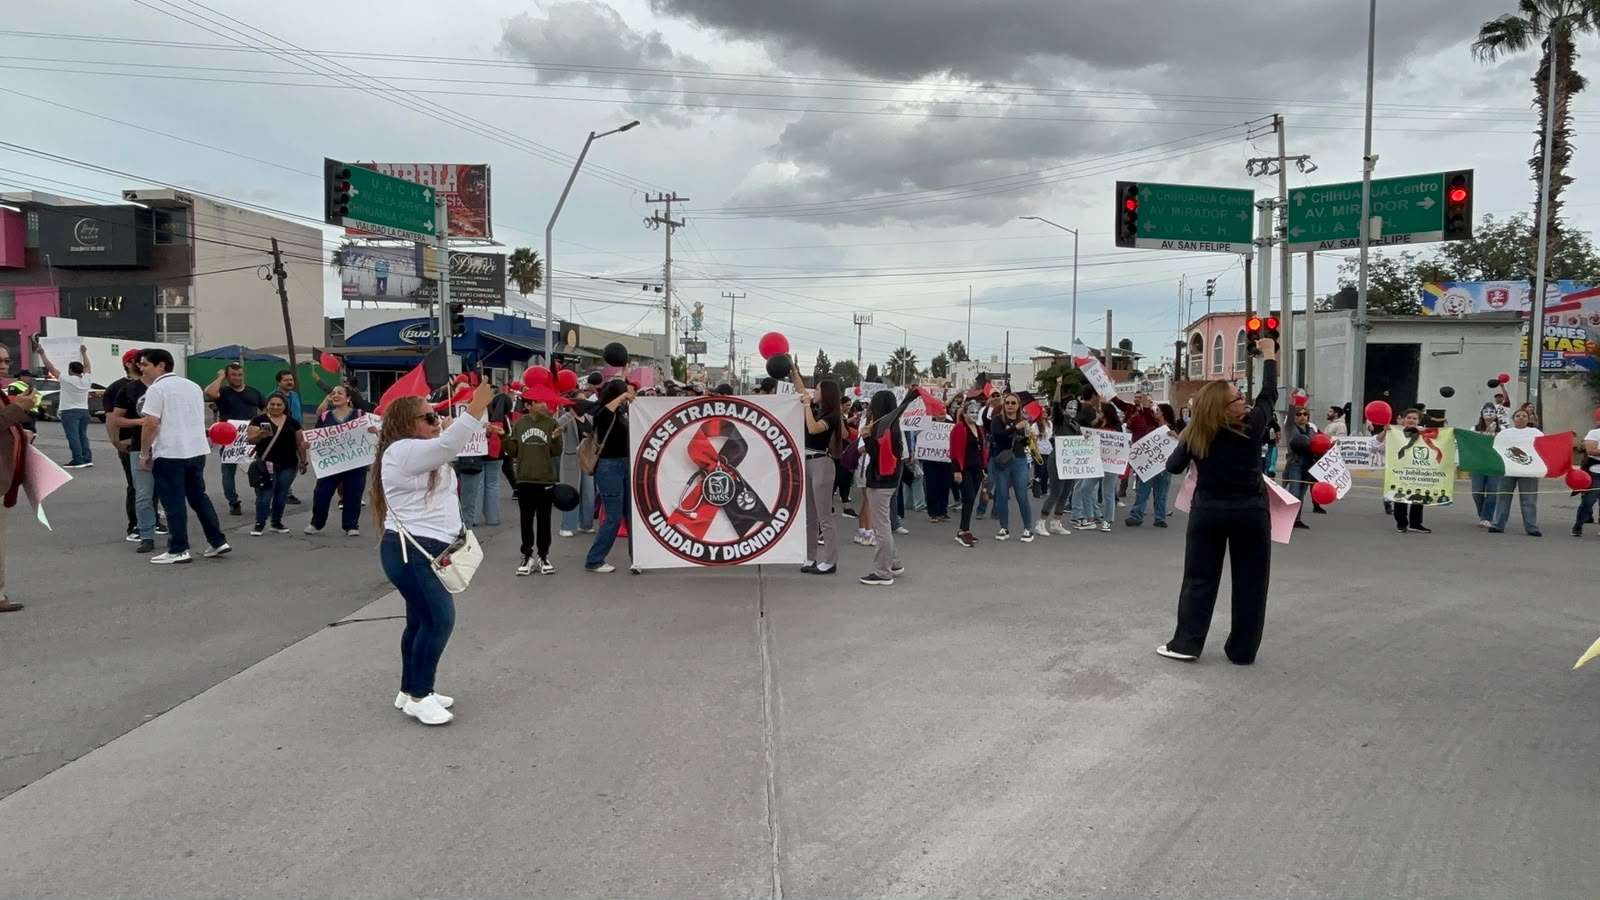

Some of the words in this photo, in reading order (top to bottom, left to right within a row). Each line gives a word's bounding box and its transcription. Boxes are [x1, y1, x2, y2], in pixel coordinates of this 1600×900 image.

[1311, 186, 1391, 204] CHIHUAUA
[1393, 181, 1439, 196] Centro
[1332, 199, 1409, 217] MIRDOR
[387, 228, 398, 237] LA
[398, 230, 426, 242] CANTERA
[1178, 241, 1198, 251] SAN
[1199, 243, 1231, 252] FELIPE
[304, 418, 369, 442] EXIGIMOS
[521, 427, 549, 443] CALIFORNIA
[642, 420, 678, 463] BASE
[675, 402, 793, 461] TRABAJADORA
[318, 443, 378, 470] ORDINARIO
[709, 493, 730, 501] IMSS
[648, 510, 704, 558] UNIDAD
[708, 545, 721, 560] Y
[723, 507, 790, 560] DIGNIDAD
